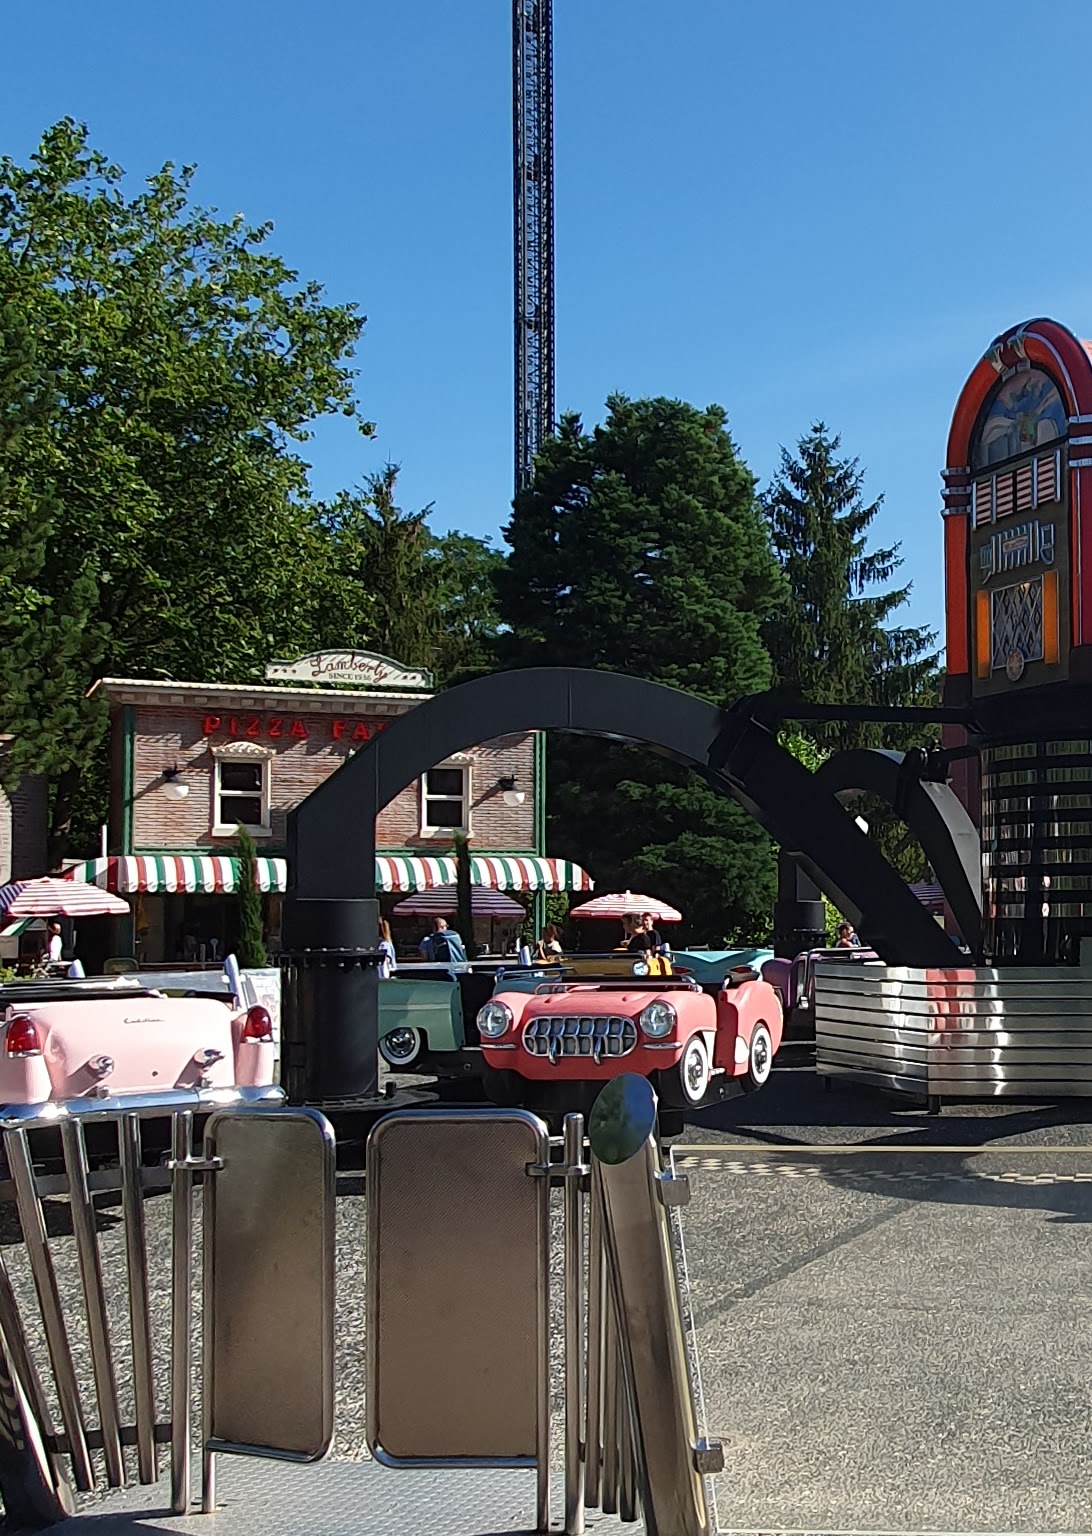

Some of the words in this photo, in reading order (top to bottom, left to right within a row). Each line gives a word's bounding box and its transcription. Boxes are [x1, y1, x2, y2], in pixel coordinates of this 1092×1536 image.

[309, 651, 389, 683] Lamberty
[328, 672, 353, 681] SINCE
[203, 716, 308, 739] PIZZA
